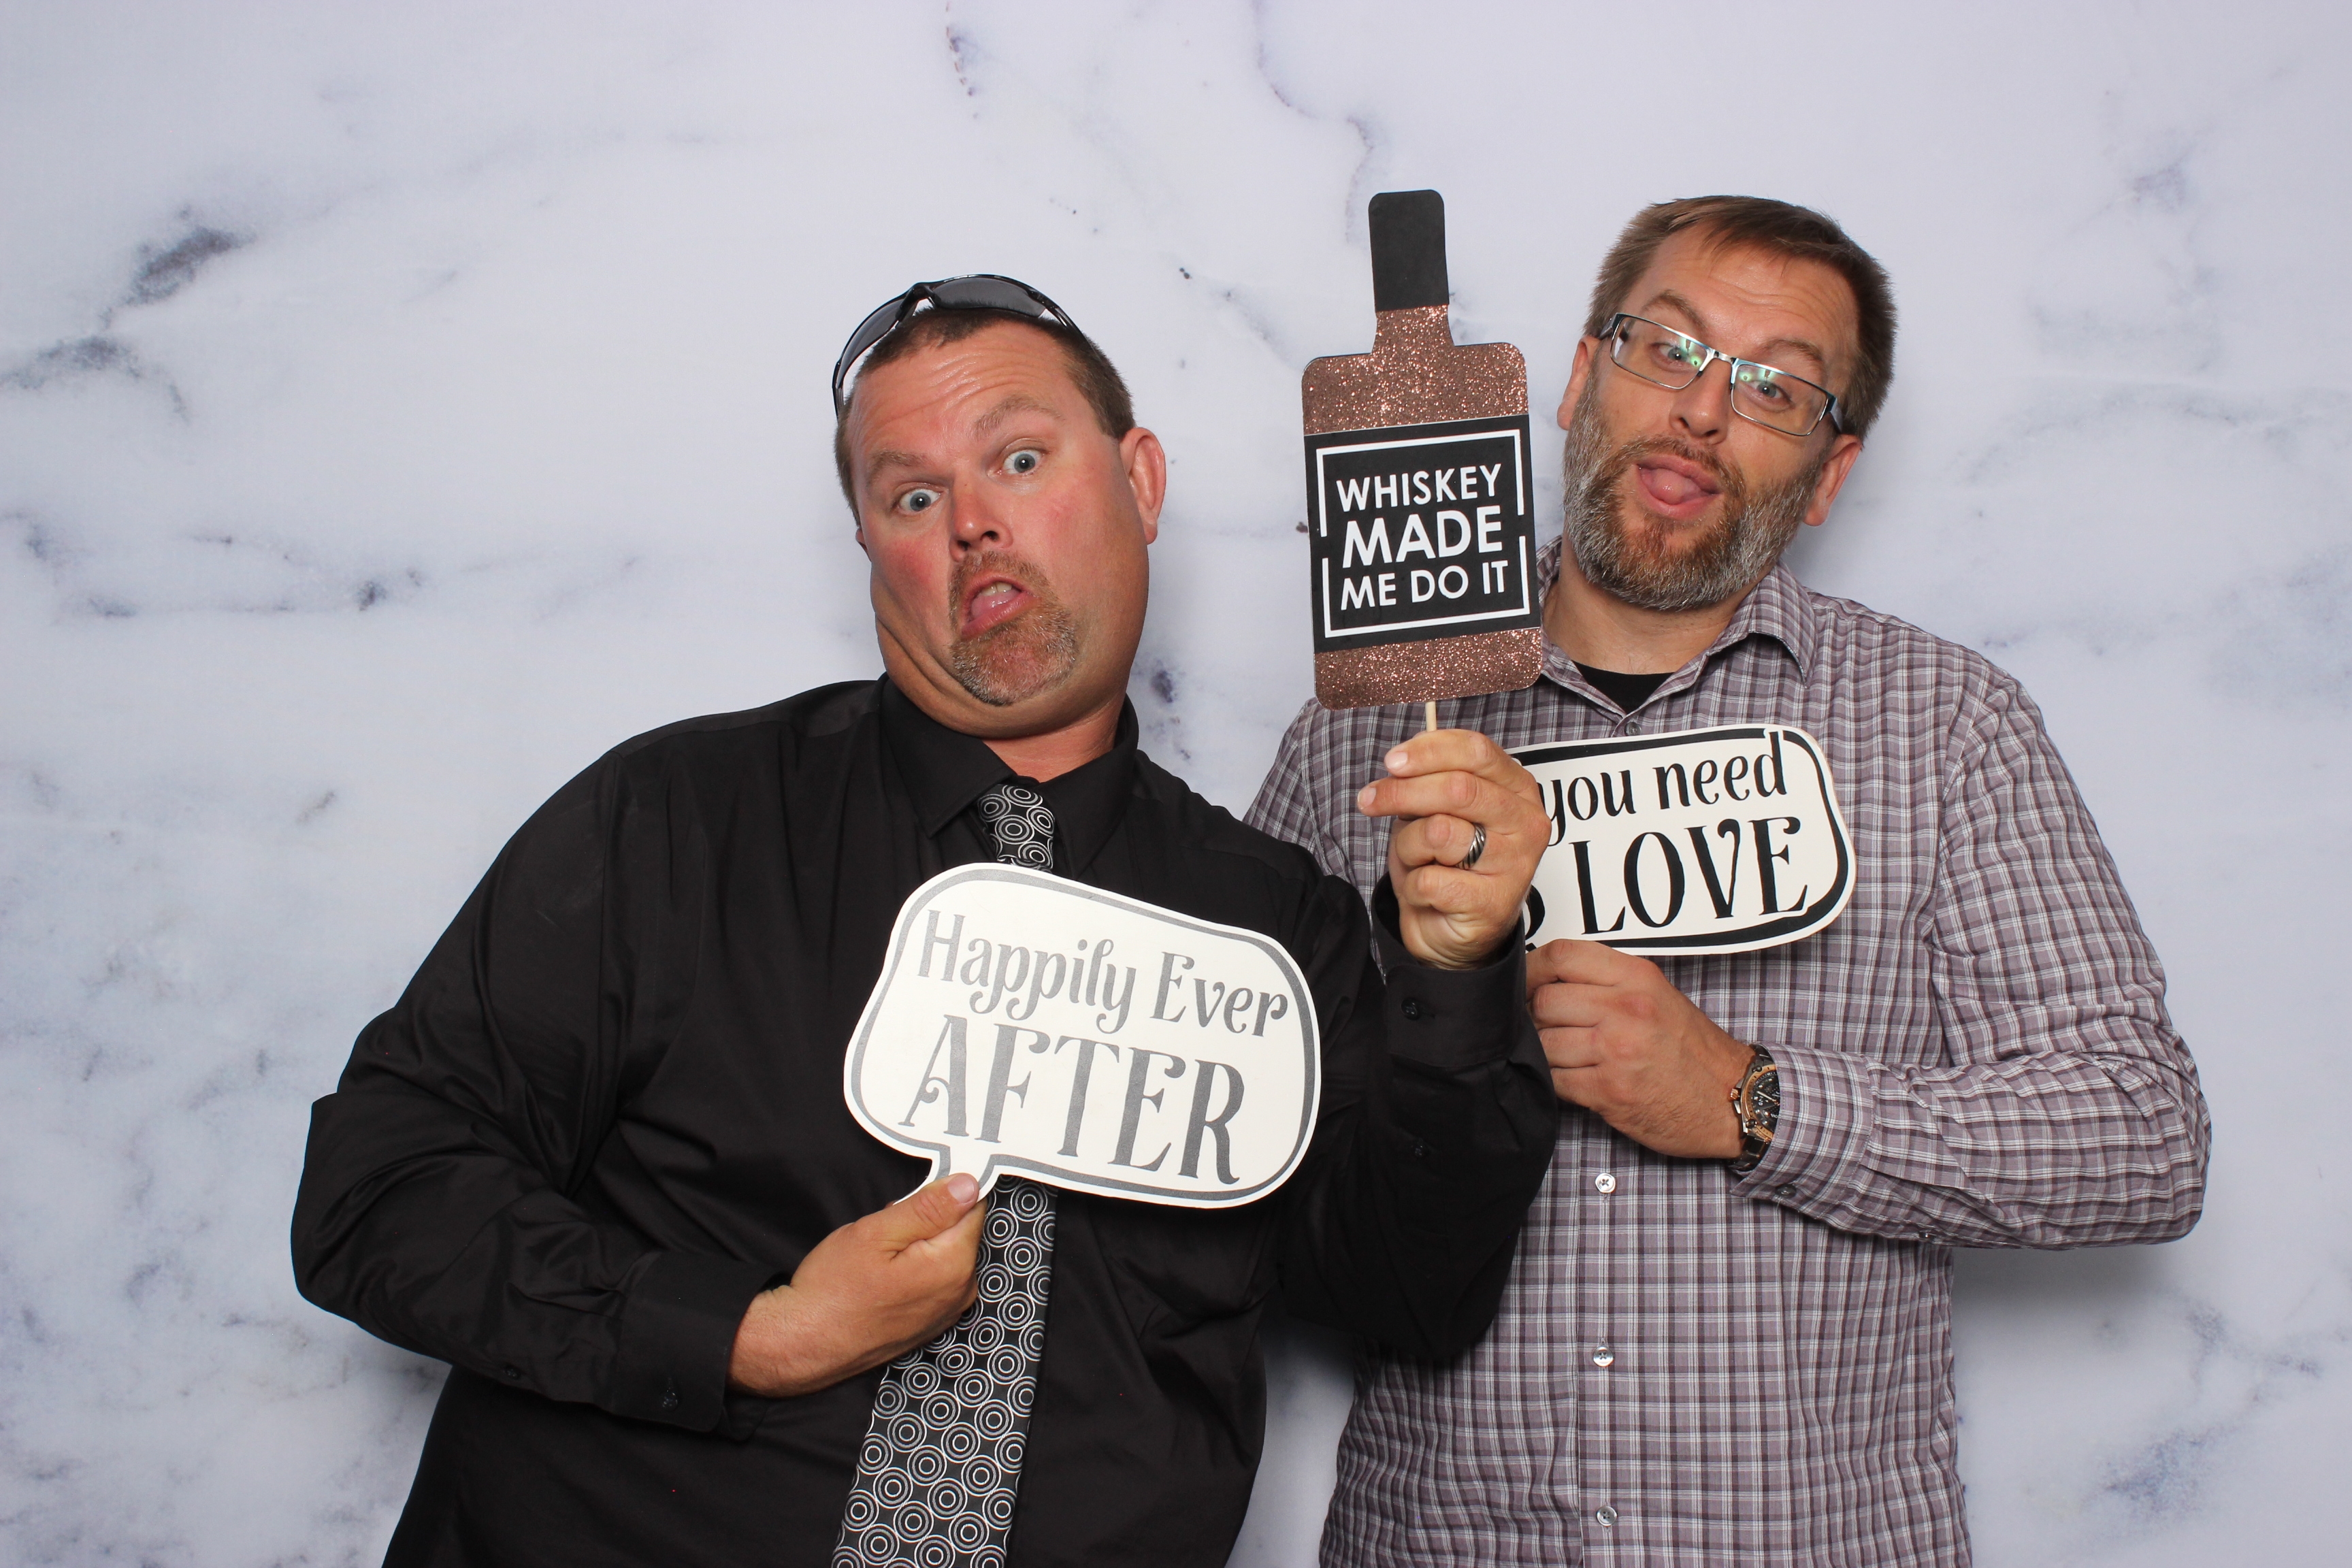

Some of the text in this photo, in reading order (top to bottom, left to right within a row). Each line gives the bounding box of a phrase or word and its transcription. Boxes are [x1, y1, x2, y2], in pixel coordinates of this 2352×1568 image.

[1336, 463, 1501, 512] WHISKEY
[1342, 505, 1503, 568] MADE
[1341, 559, 1509, 610] ME DO IT
[1536, 731, 1788, 847] you need
[1569, 817, 1808, 935] LOVE
[917, 909, 1288, 1037] Happily Ever
[897, 1014, 1245, 1185] AFTER
